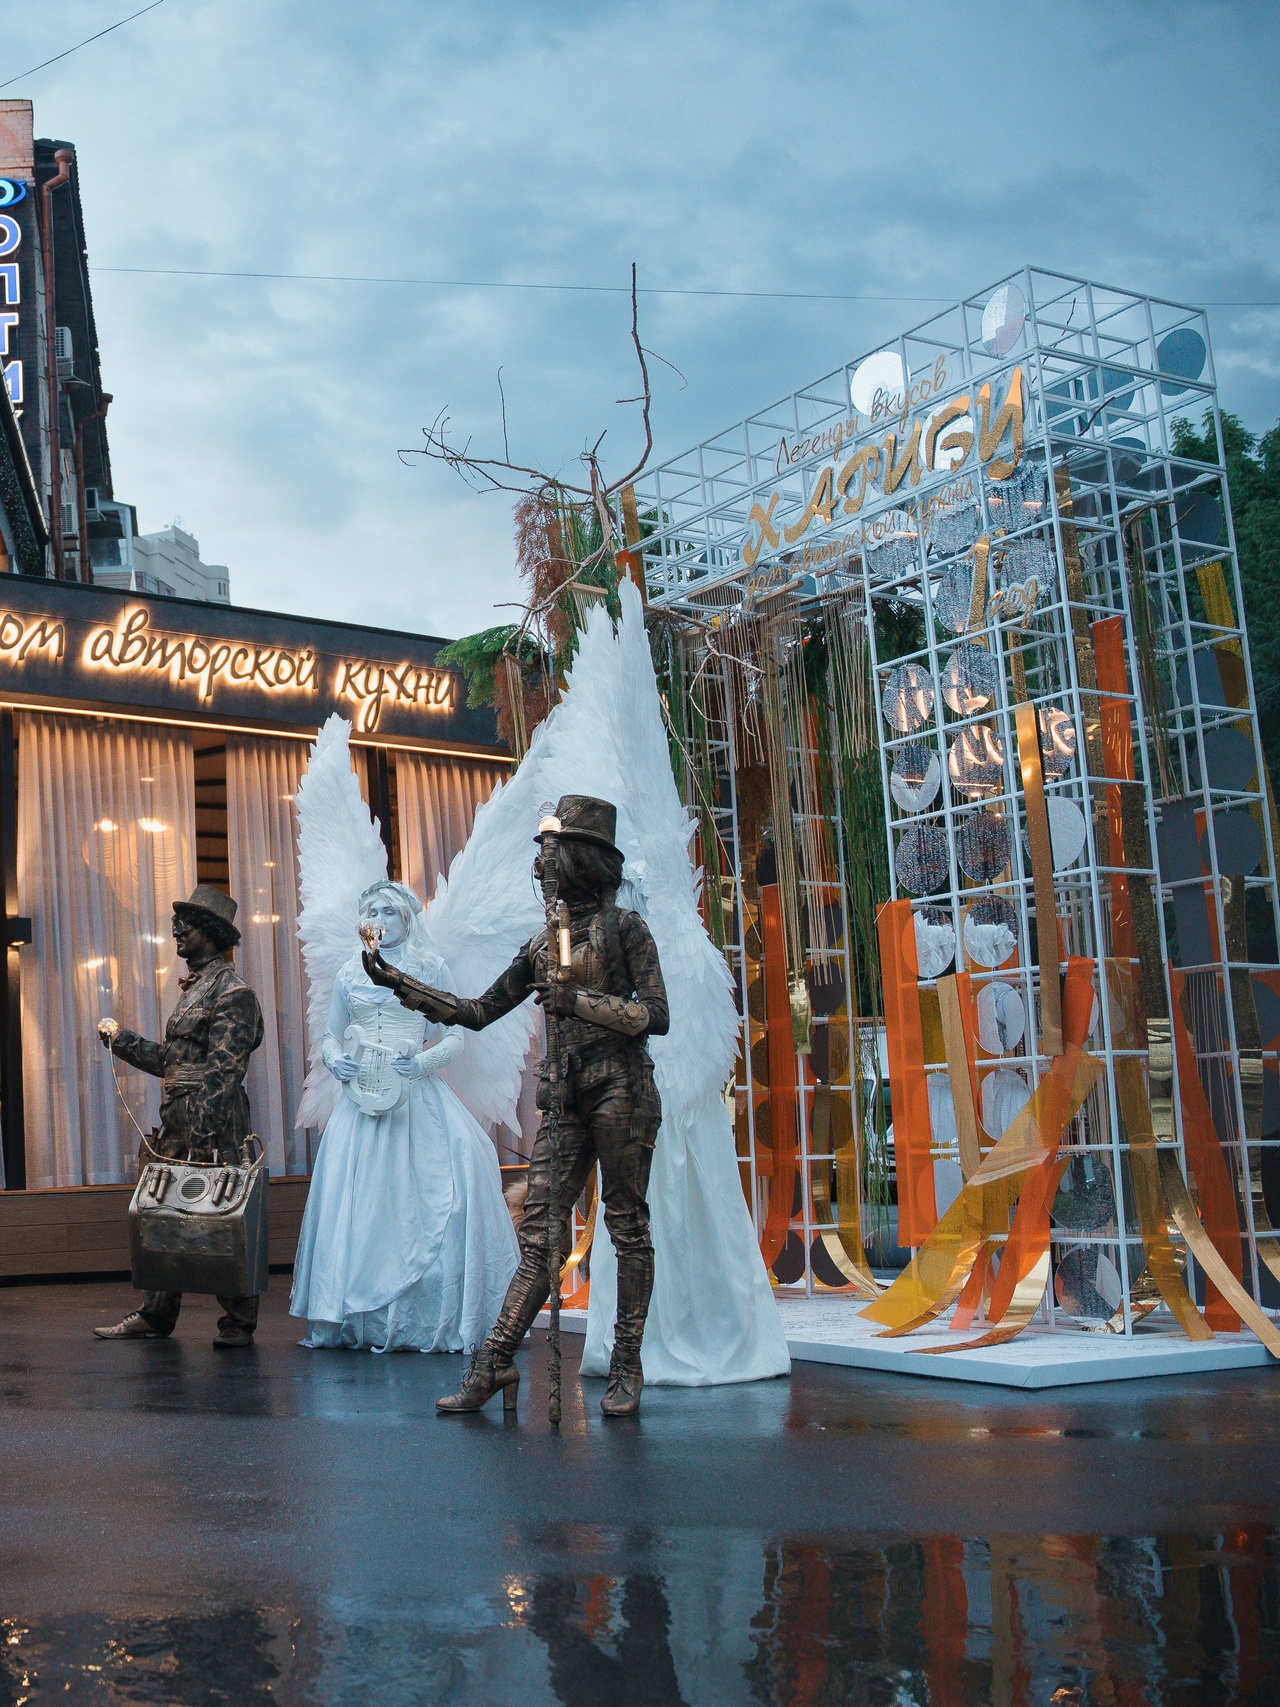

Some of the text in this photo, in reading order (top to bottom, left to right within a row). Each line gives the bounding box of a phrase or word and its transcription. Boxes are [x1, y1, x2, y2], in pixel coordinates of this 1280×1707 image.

[742, 365, 1024, 567] ХАРИБУ
[776, 354, 947, 477] Легенды вкусов
[987, 577, 1039, 630] год
[89, 608, 320, 697] авторской
[340, 660, 456, 733] кухни
